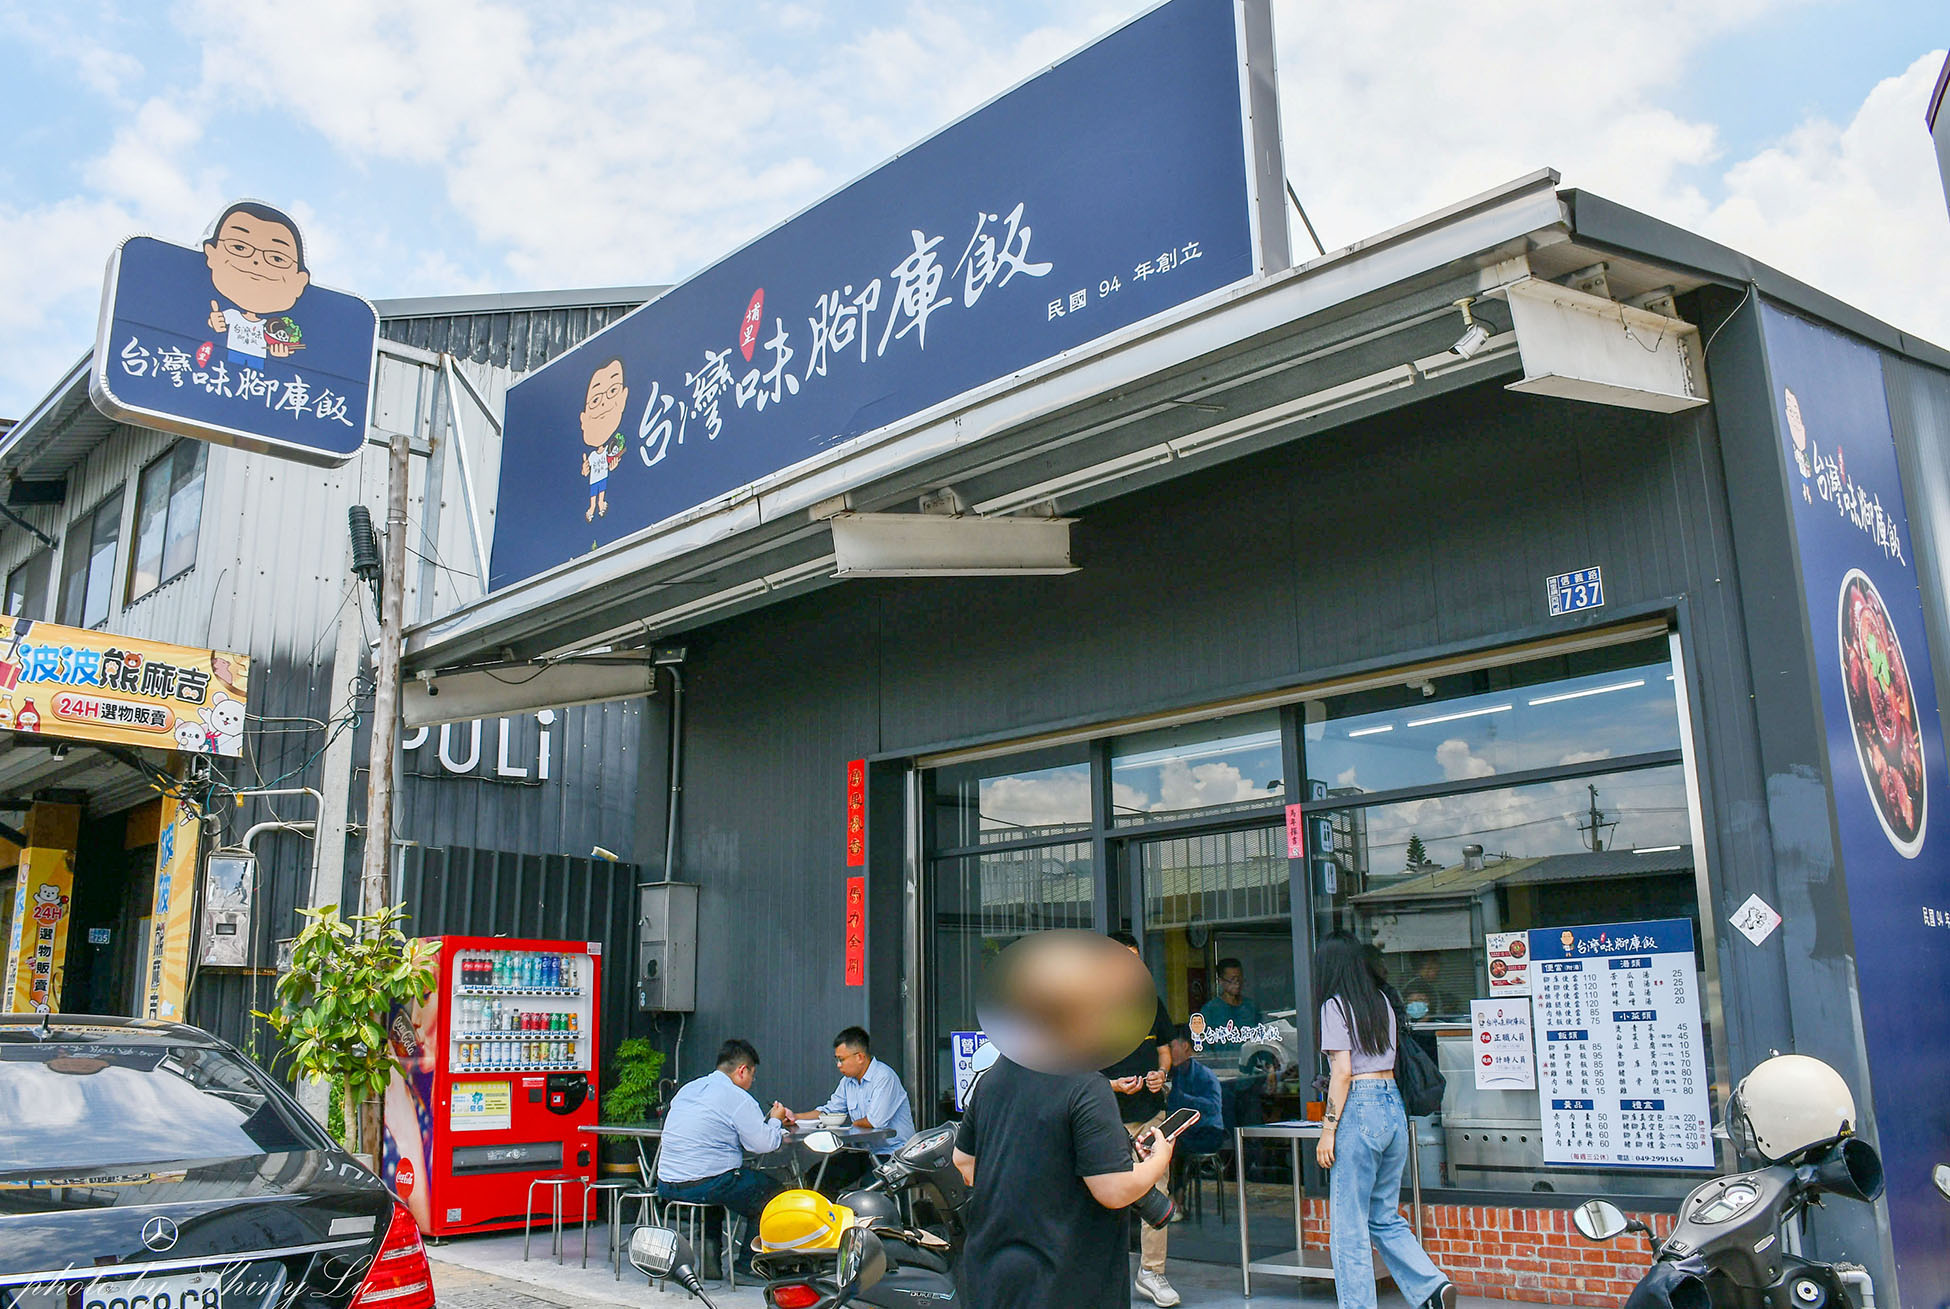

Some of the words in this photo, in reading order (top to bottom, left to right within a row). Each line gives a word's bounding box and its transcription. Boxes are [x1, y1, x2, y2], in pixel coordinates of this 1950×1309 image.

[1048, 289, 1087, 321] 民國
[1099, 276, 1121, 298] 94
[1133, 241, 1203, 281] 年創立
[742, 302, 761, 348] 埔里
[637, 202, 1053, 467] 台灣味腳庫飯
[121, 336, 354, 427] 台灣味腳庫飯
[1561, 582, 1600, 610] 737
[18, 643, 211, 704] 波波熊麻吉
[402, 709, 555, 780] ULi
[33, 906, 62, 920] 24H
[1577, 934, 1658, 954] 台灣味腳庫飯
[34, 927, 54, 992] 選物販賣
[1583, 973, 1597, 981] 110
[1672, 969, 1683, 977] 25
[1584, 982, 1598, 990] 120
[1673, 978, 1684, 986] 25
[1584, 991, 1599, 999] 110
[1674, 987, 1685, 995] 20
[1585, 999, 1599, 1008] 120
[1675, 996, 1686, 1005] 20
[1590, 1008, 1600, 1016] 85
[1591, 1017, 1601, 1025] 75
[1676, 1022, 1688, 1031] 45
[1494, 1032, 1526, 1042] 正職人員
[1558, 1031, 1578, 1040] 飯類
[1677, 1032, 1689, 1040] 45
[1592, 1042, 1602, 1051] 85
[1679, 1041, 1690, 1049] 10
[1592, 1051, 1603, 1060] 95
[1680, 1050, 1691, 1058] 15
[1495, 1056, 1526, 1064] 計時人員
[1593, 1060, 1604, 1069] 85
[1680, 1059, 1691, 1067] 70
[1594, 1069, 1605, 1077] 95
[1681, 1068, 1692, 1077] 80
[1594, 1078, 1605, 1086] 50
[1682, 1077, 1693, 1086] 70
[1596, 1087, 1606, 1095] 15
[1682, 1086, 1694, 1095] 80
[1597, 1112, 1608, 1121] 50
[1683, 1114, 1697, 1122] 220
[1598, 1121, 1609, 1130] 60
[1684, 1123, 1697, 1131] 250
[1598, 1130, 1609, 1139] 60
[1685, 1132, 1698, 1140] 470
[1599, 1139, 1610, 1148] 60
[1686, 1141, 1699, 1150] 530
[1635, 1155, 1684, 1163] 049-2991563
